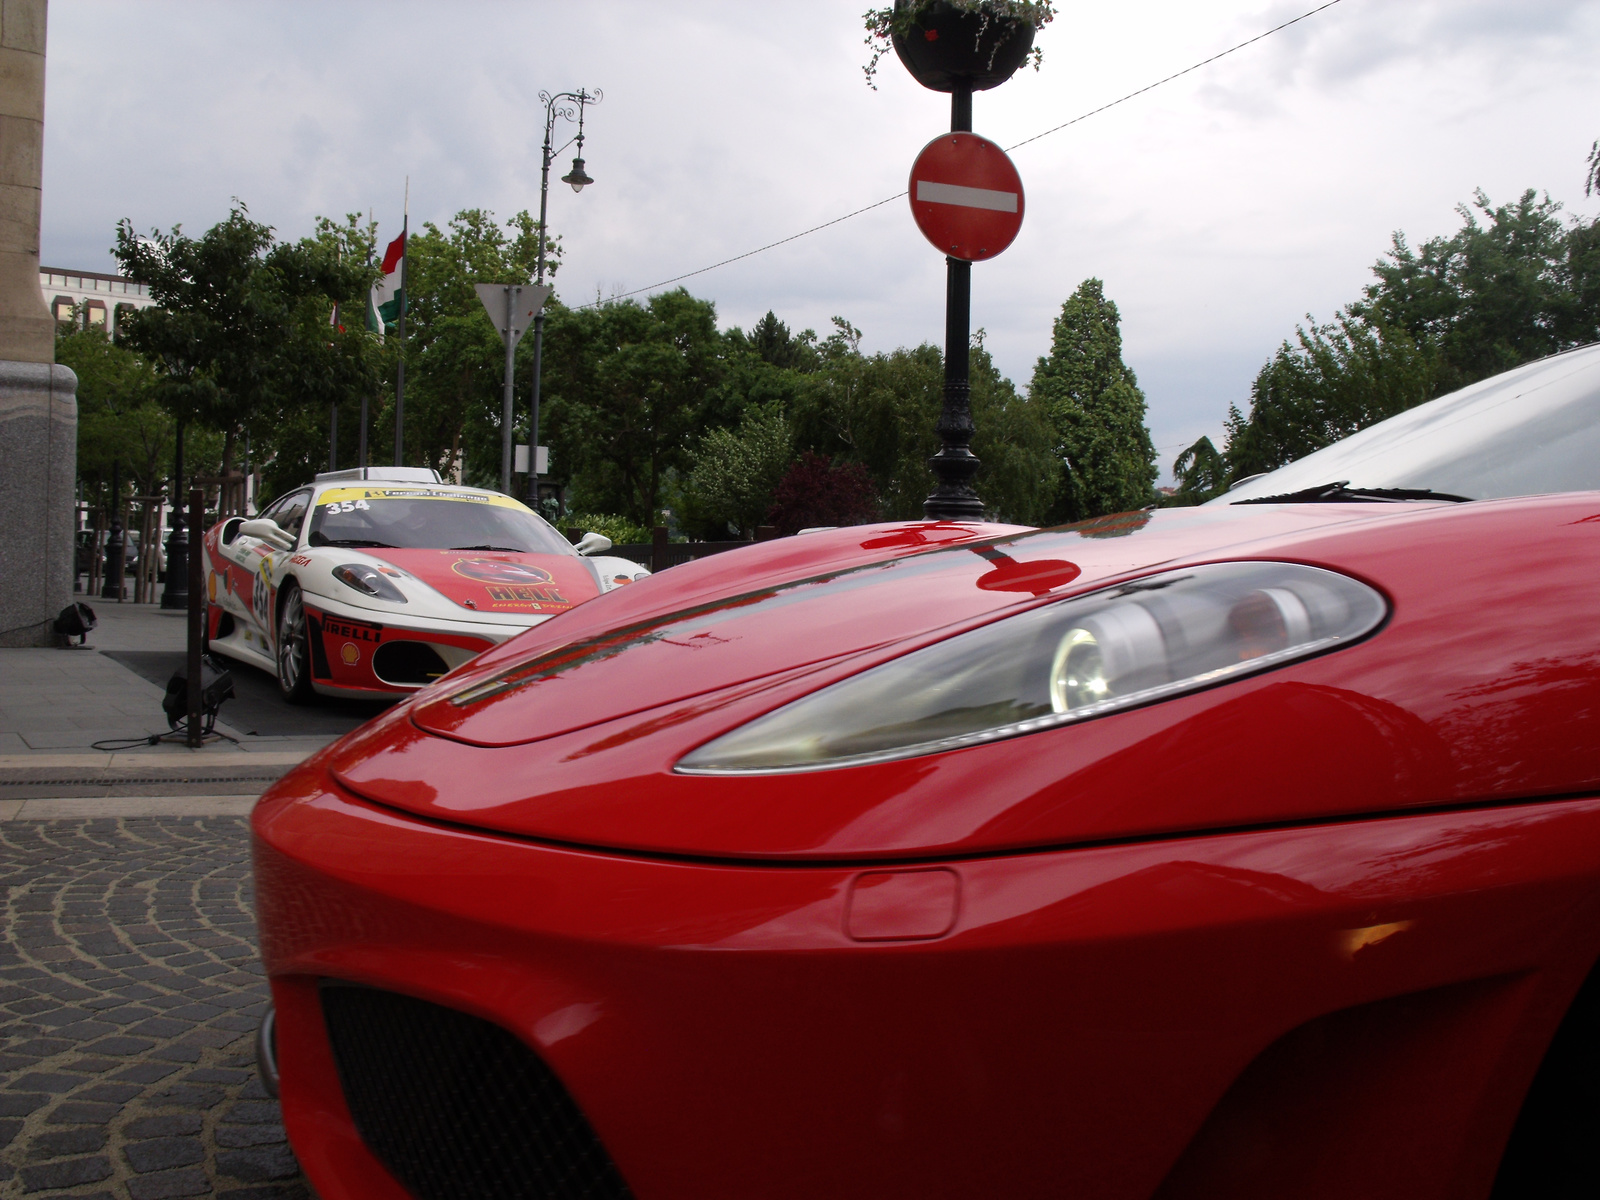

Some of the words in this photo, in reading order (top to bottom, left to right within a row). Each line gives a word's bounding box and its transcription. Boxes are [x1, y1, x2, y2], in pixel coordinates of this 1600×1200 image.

[325, 500, 370, 515] 354
[485, 586, 569, 603] HELL
[321, 613, 383, 643] PIRELLI
